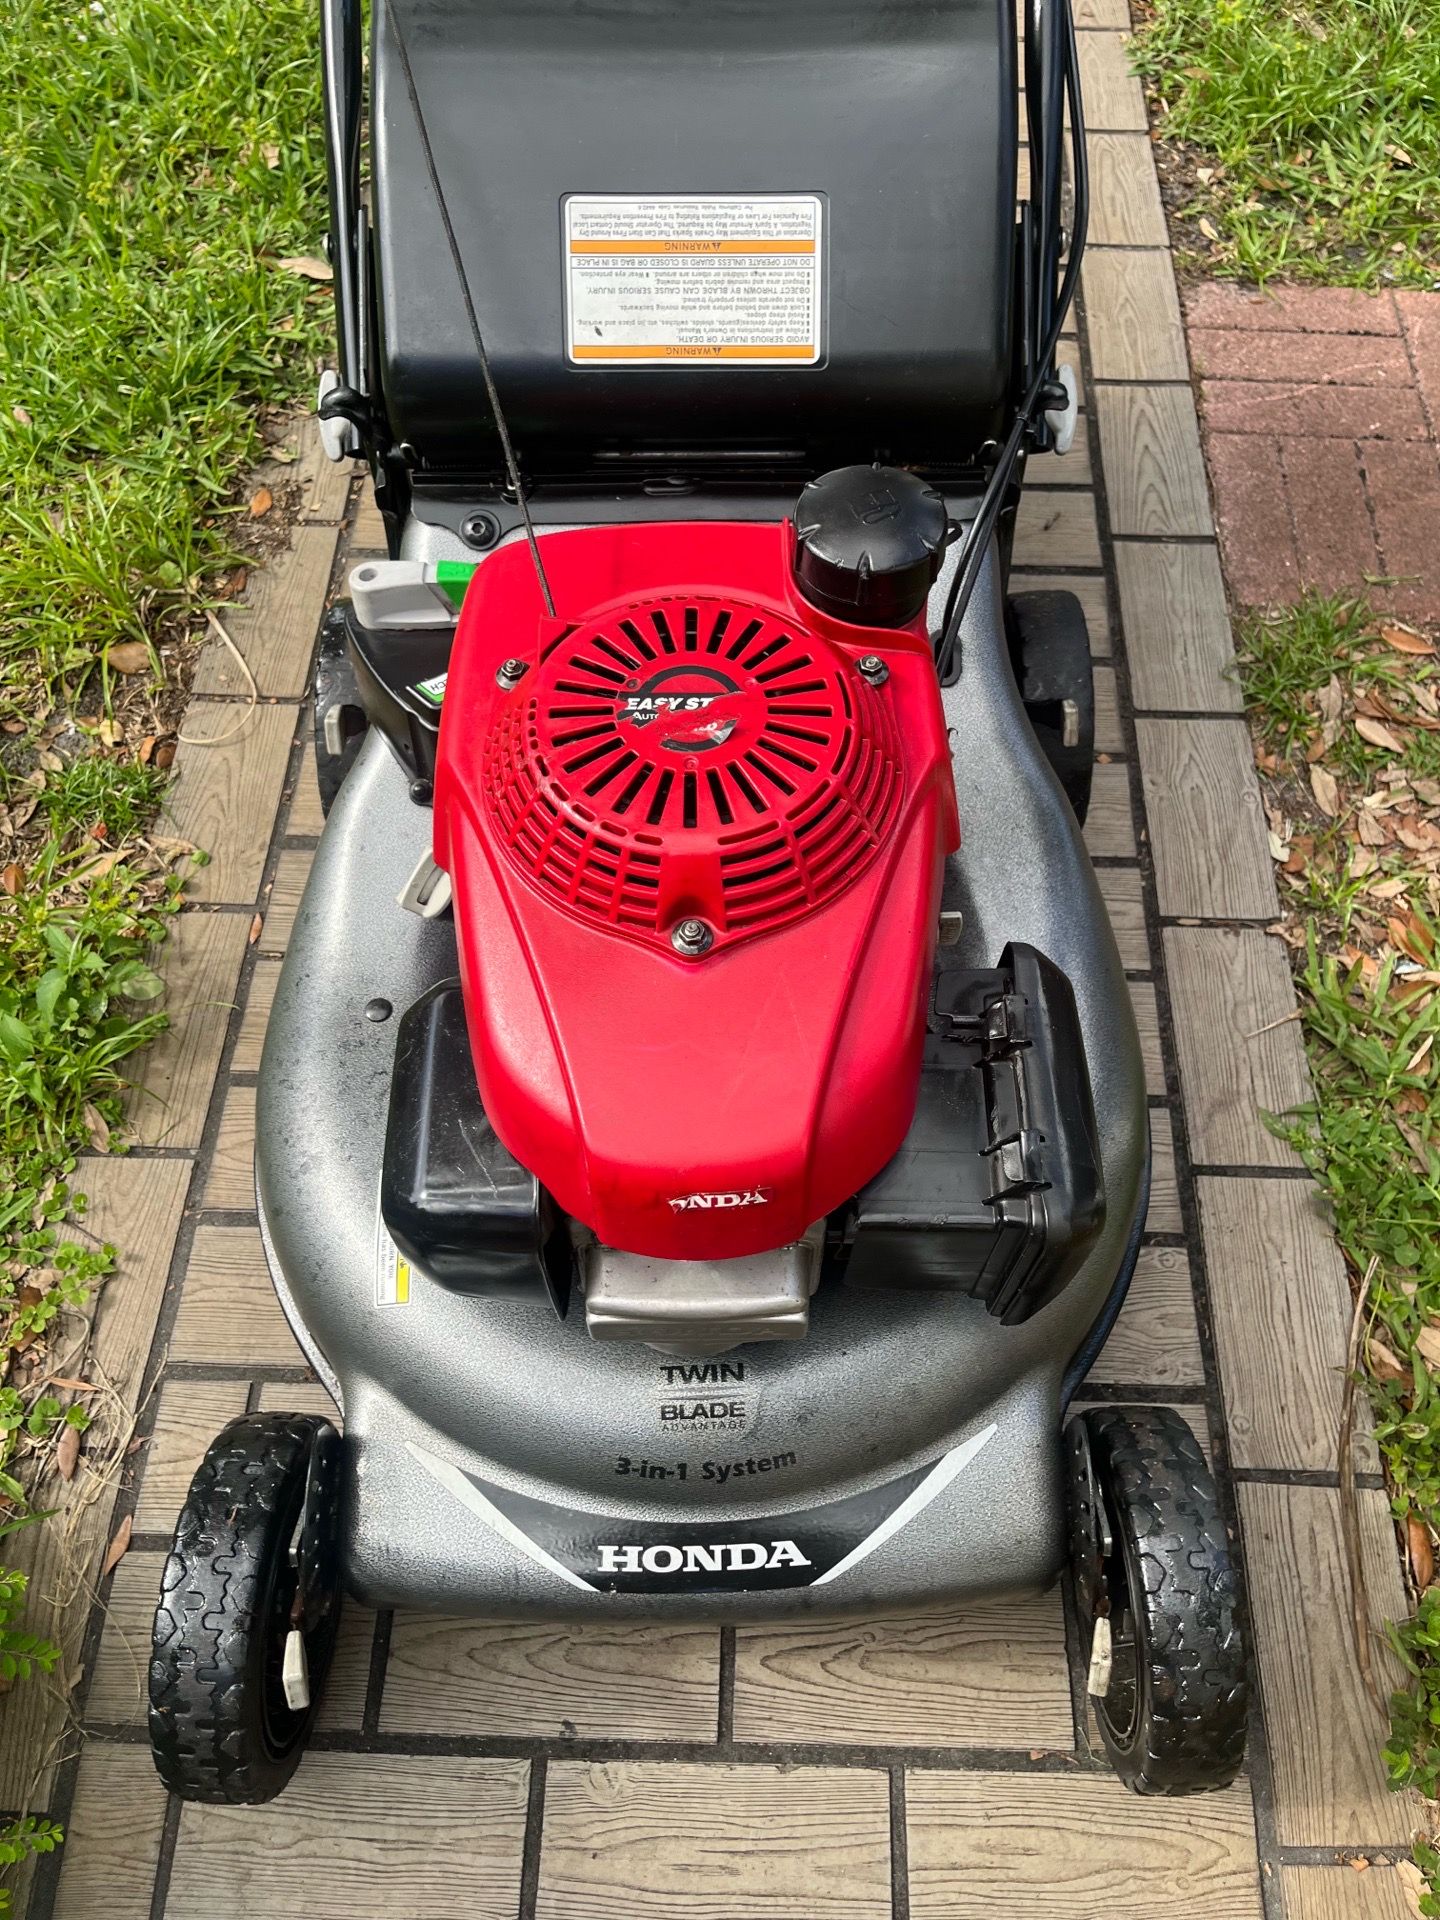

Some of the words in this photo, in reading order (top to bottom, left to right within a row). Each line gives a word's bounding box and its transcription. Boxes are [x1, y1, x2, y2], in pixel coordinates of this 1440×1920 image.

[664, 242, 709, 250] WARNING
[625, 697, 684, 710] EASY
[660, 1363, 745, 1384] TWIN
[661, 1401, 746, 1420] BLADE
[662, 1420, 746, 1431] ADVANTAGE
[615, 1455, 687, 1480] 3-in-1
[703, 1451, 797, 1484] System
[598, 1540, 812, 1573] HONDA
